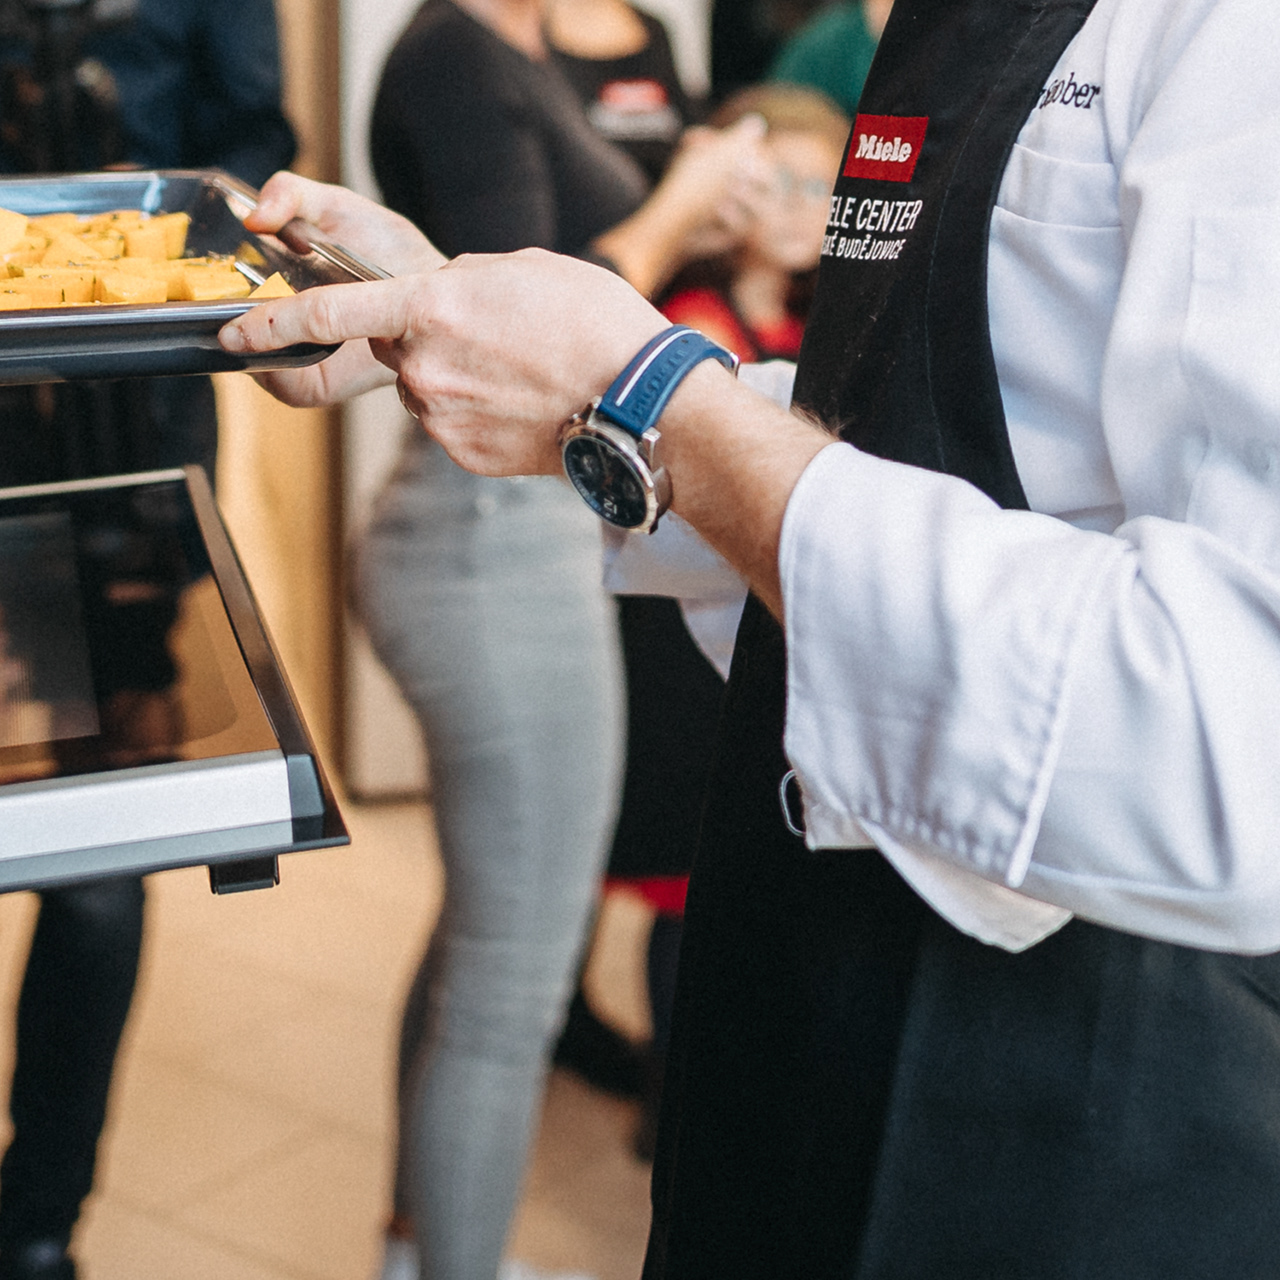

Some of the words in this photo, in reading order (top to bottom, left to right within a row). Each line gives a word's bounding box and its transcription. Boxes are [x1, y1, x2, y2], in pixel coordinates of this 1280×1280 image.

[855, 133, 912, 163] Miele
[856, 198, 923, 233] CENTER
[836, 233, 907, 260] BUDĚJOVICE
